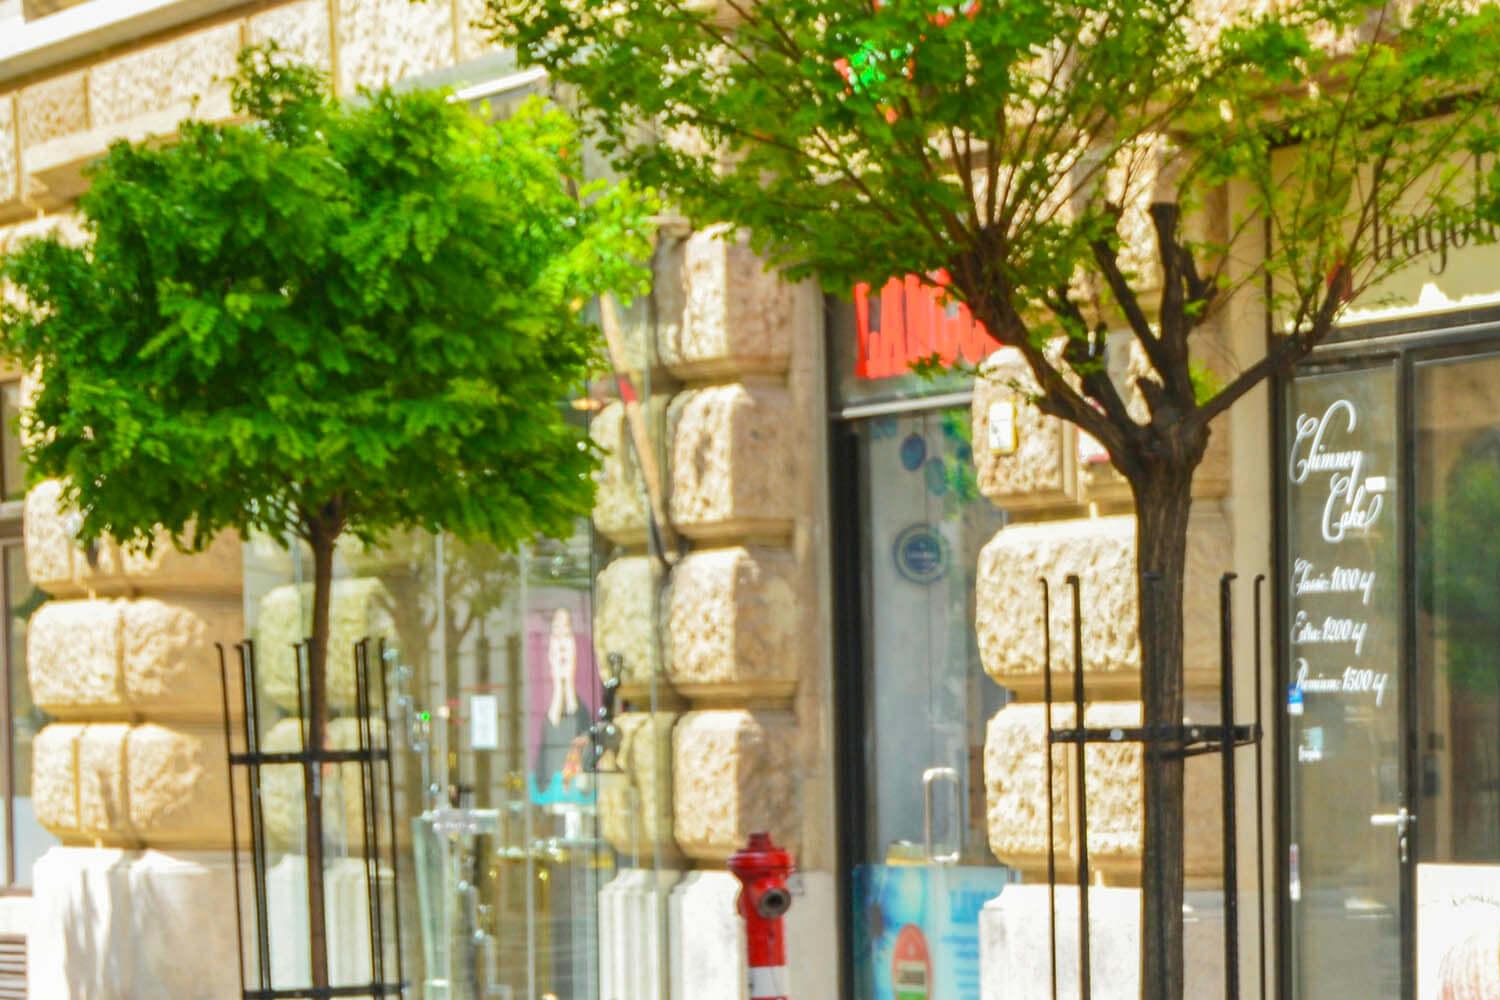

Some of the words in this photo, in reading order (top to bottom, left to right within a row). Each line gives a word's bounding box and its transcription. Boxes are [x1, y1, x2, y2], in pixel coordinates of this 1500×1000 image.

[1289, 399, 1364, 504] Chimney
[1322, 472, 1384, 543] Cake
[1330, 566, 1361, 592] 1000
[1323, 616, 1353, 642] 1200
[1342, 666, 1374, 691] 1500
